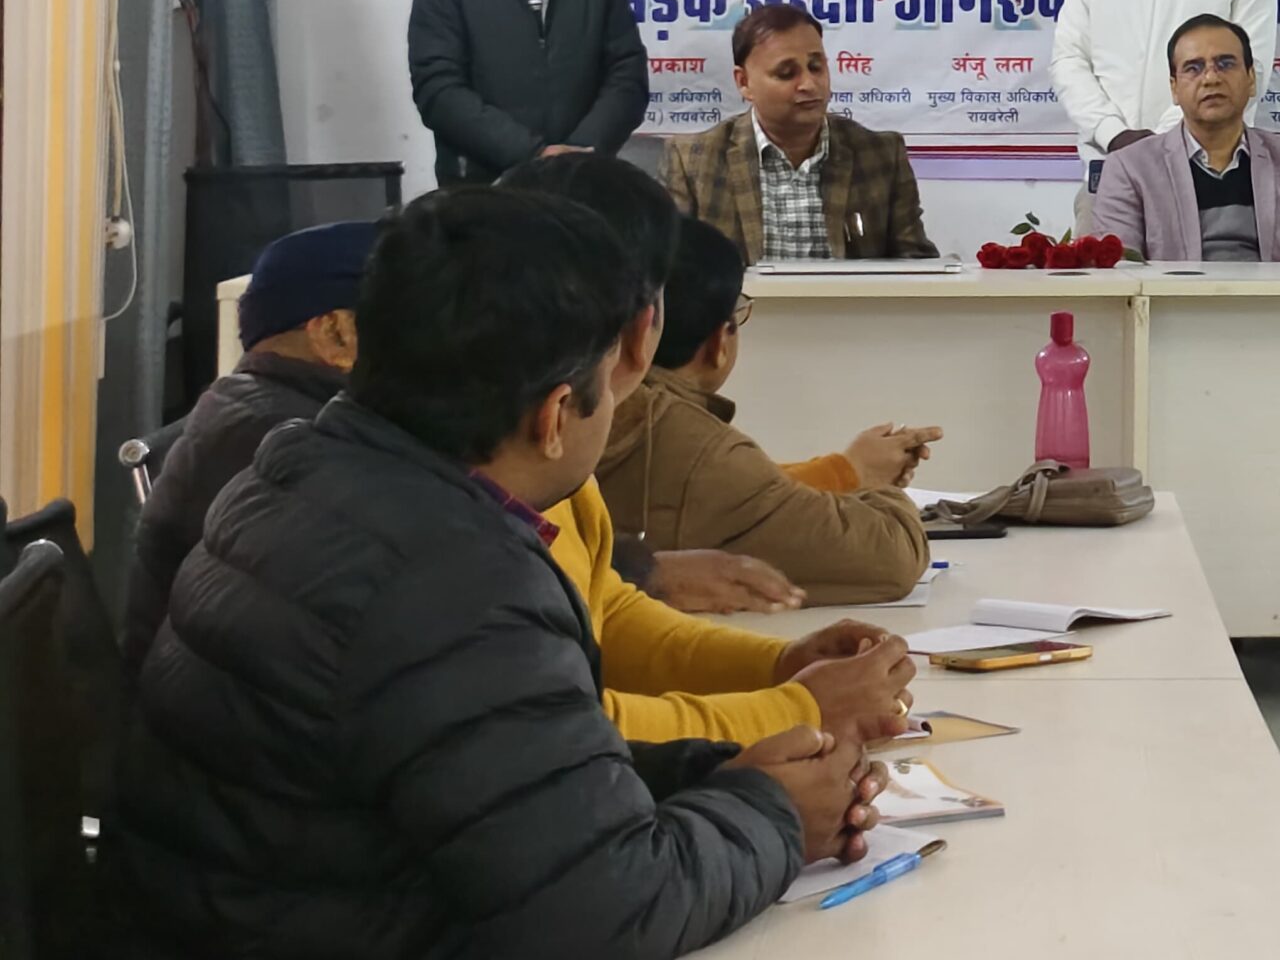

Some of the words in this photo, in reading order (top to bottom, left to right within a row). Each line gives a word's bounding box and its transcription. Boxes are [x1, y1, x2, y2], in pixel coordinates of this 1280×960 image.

[836, 50, 875, 76] सिंह
[952, 52, 989, 80] अंजू
[994, 57, 1034, 73] लता
[669, 87, 722, 103] अधिकारी
[859, 87, 912, 103] अधिकारी
[926, 91, 956, 108] मुख्य
[961, 87, 1002, 103] विकास
[669, 107, 722, 123] रायबरेली
[967, 107, 1019, 123] रायबरेली
